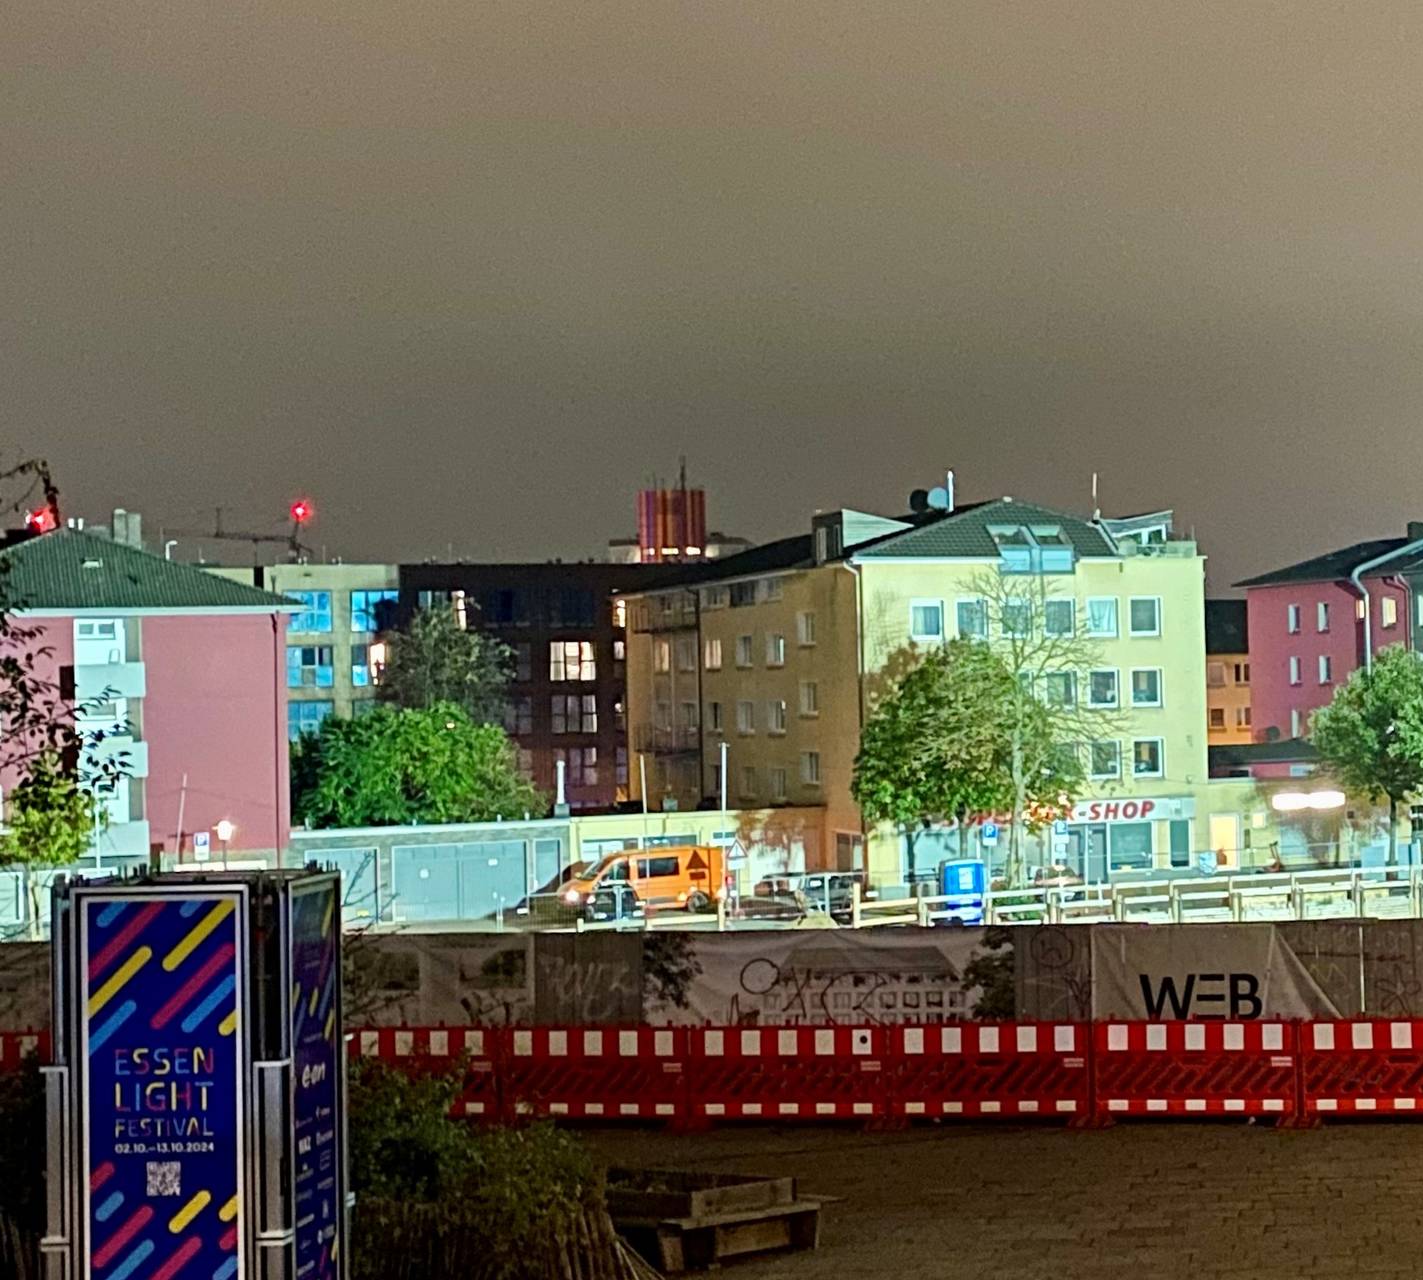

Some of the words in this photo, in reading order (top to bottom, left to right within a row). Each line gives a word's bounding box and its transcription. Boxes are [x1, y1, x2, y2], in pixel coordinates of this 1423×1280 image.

[114, 1046, 215, 1076] ESSEN
[114, 1081, 215, 1112] LIGHT
[115, 1117, 215, 1138] FESTIVAL
